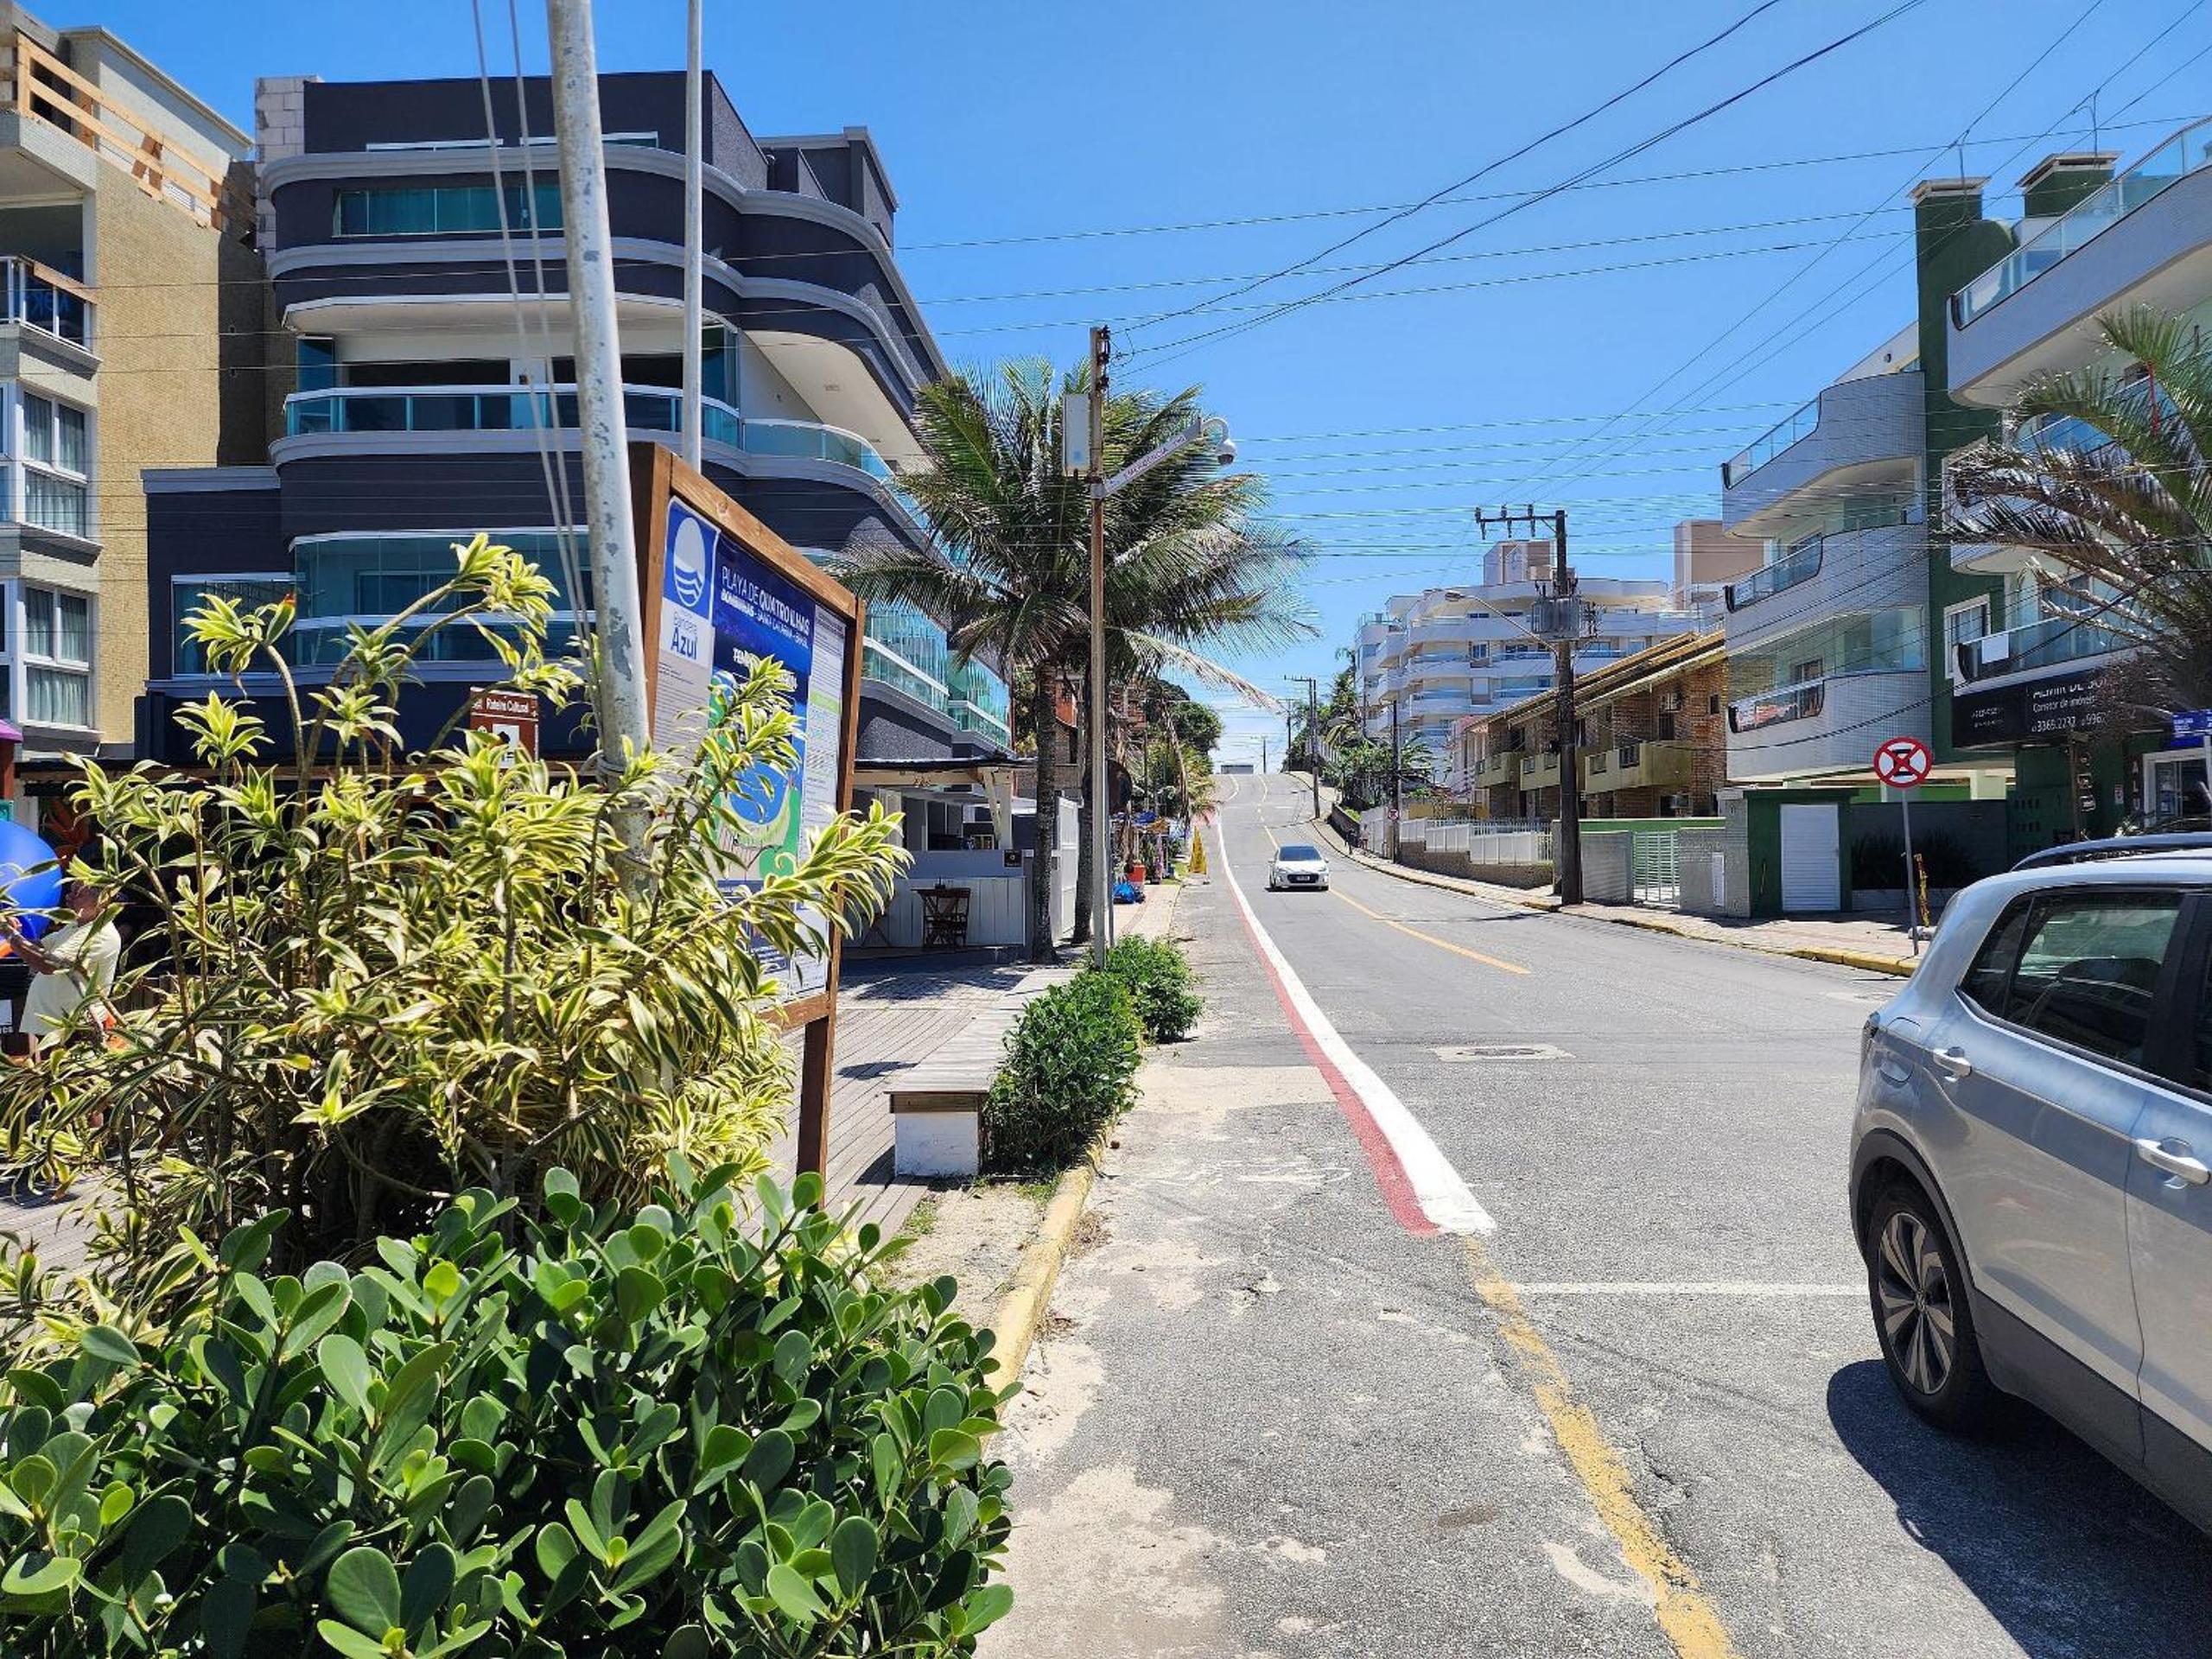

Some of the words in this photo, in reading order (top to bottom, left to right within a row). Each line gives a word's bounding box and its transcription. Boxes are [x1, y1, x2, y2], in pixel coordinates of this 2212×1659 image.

[721, 566, 748, 596] PLAYA
[748, 582, 760, 605] DE
[760, 589, 790, 623] QUATRO
[790, 608, 810, 636] ILHAS
[670, 626, 698, 660] Azul
